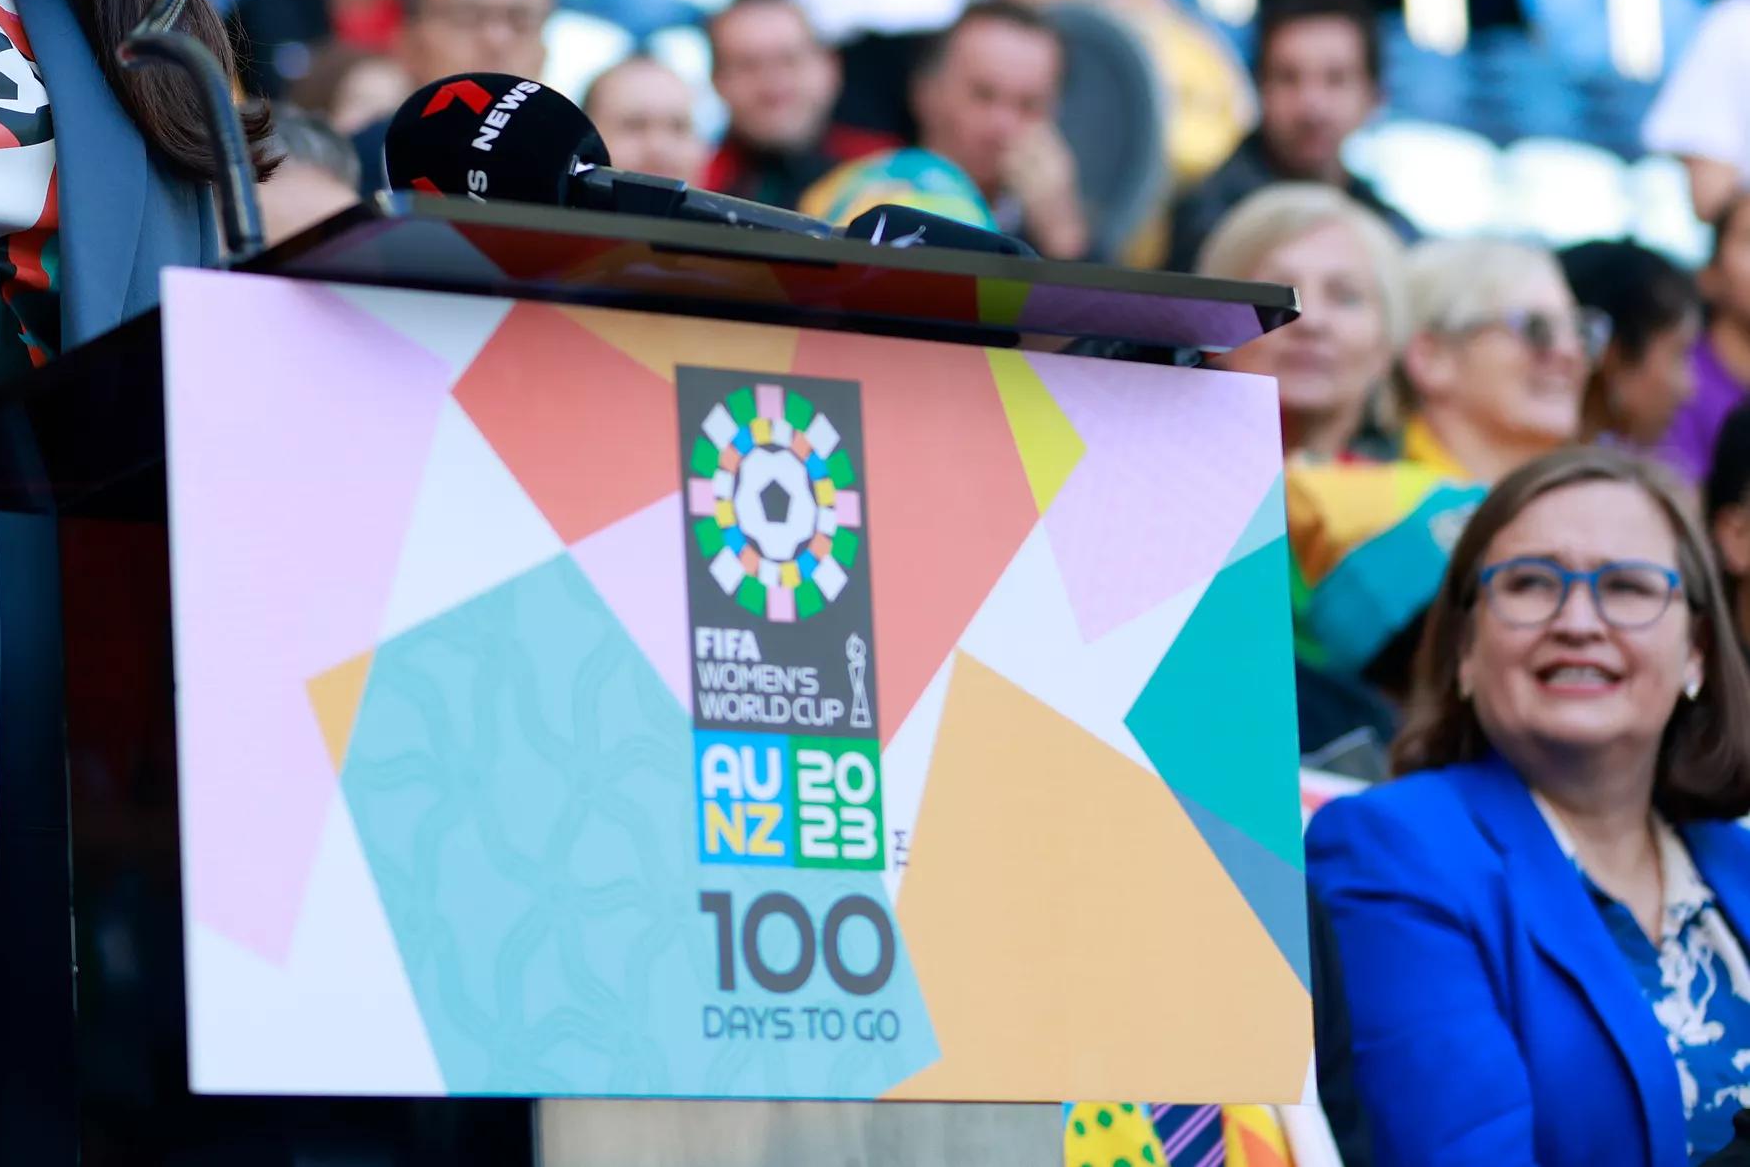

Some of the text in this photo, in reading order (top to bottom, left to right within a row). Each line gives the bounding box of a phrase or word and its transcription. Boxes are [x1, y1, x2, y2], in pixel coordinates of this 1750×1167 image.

[471, 80, 541, 152] NEWS
[695, 626, 762, 662] FIFA
[697, 662, 820, 696] WOMEN'S
[699, 691, 846, 727] WORLD CUP
[702, 742, 877, 805] AU 20
[705, 800, 879, 861] NZ 23
[698, 889, 897, 997] 100
[702, 1004, 901, 1043] DAYS TO GO
